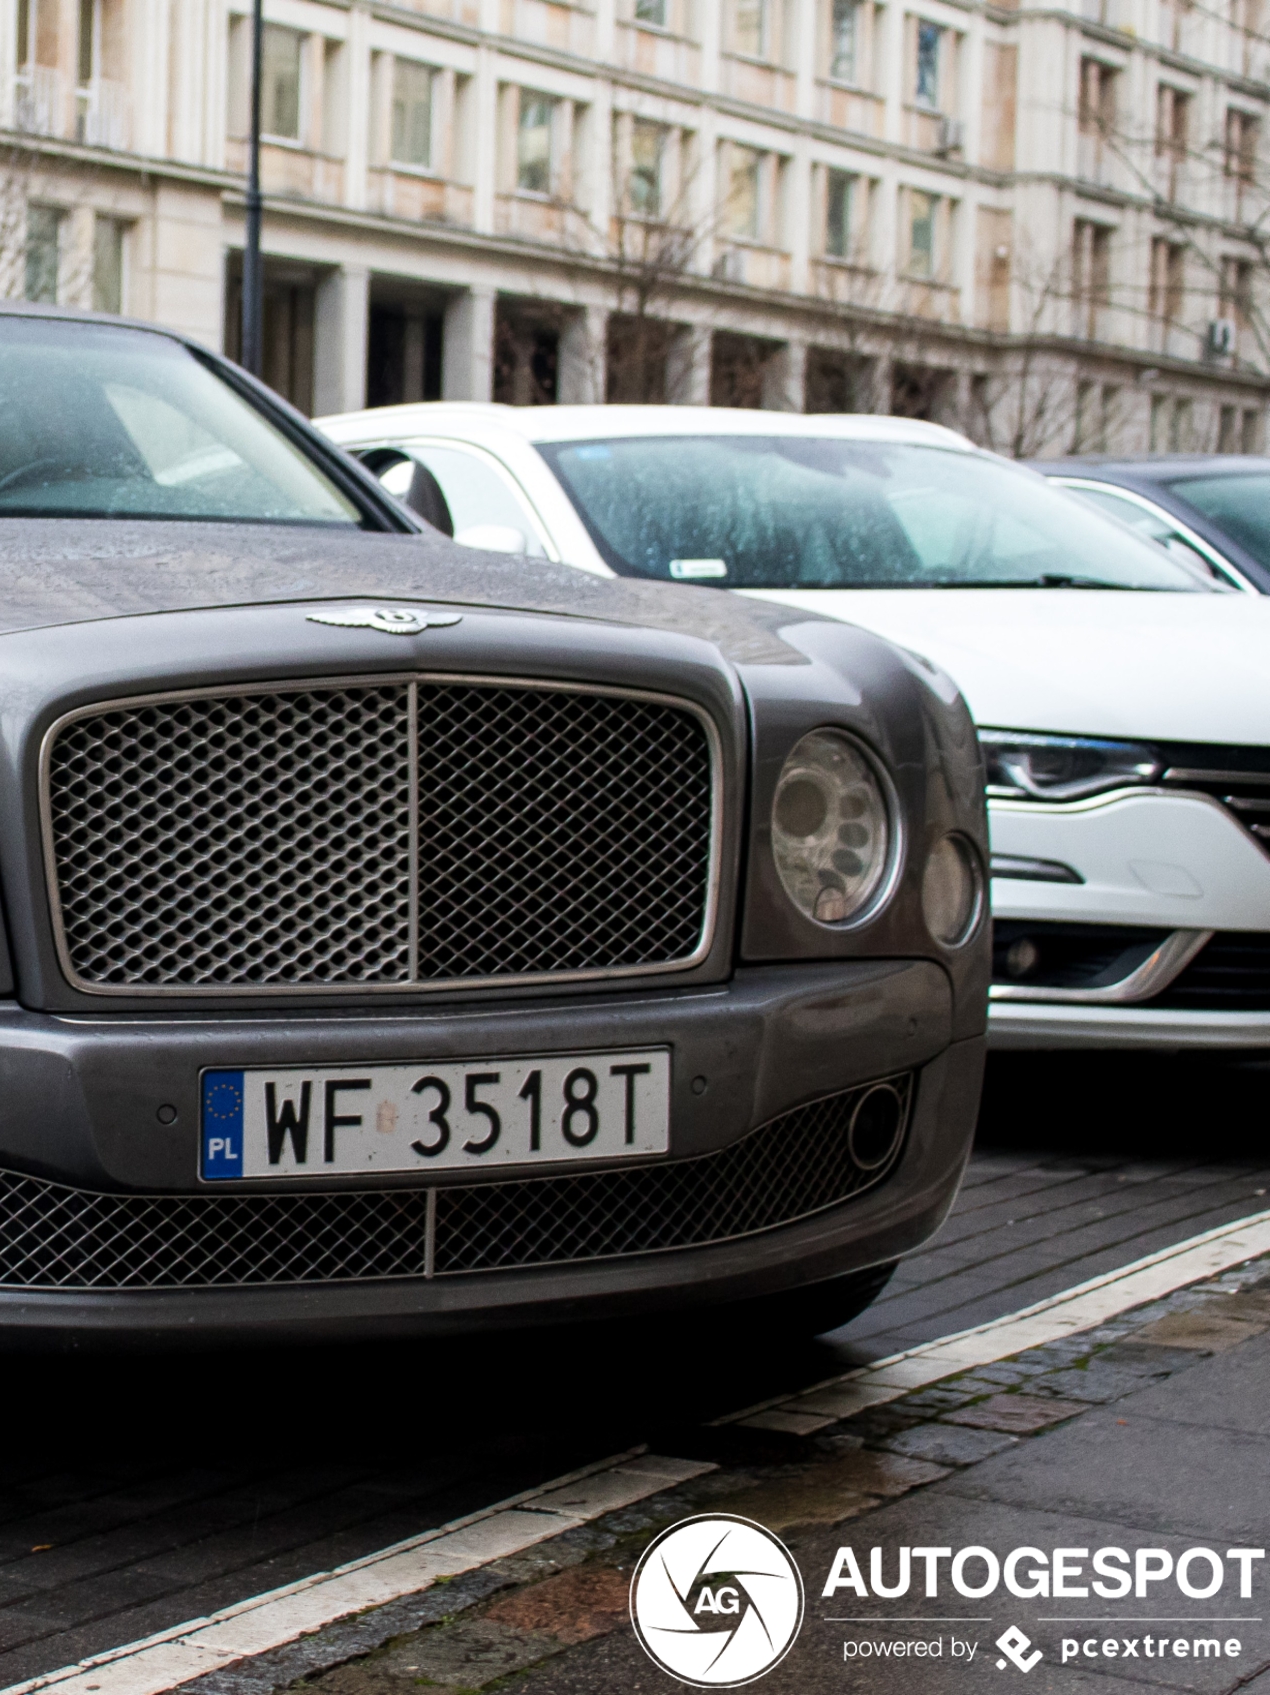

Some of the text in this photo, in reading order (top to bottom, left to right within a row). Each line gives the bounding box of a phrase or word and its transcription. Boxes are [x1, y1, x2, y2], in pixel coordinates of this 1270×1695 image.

[264, 1062, 652, 1165] WF 3518T
[208, 1137, 238, 1160] PL
